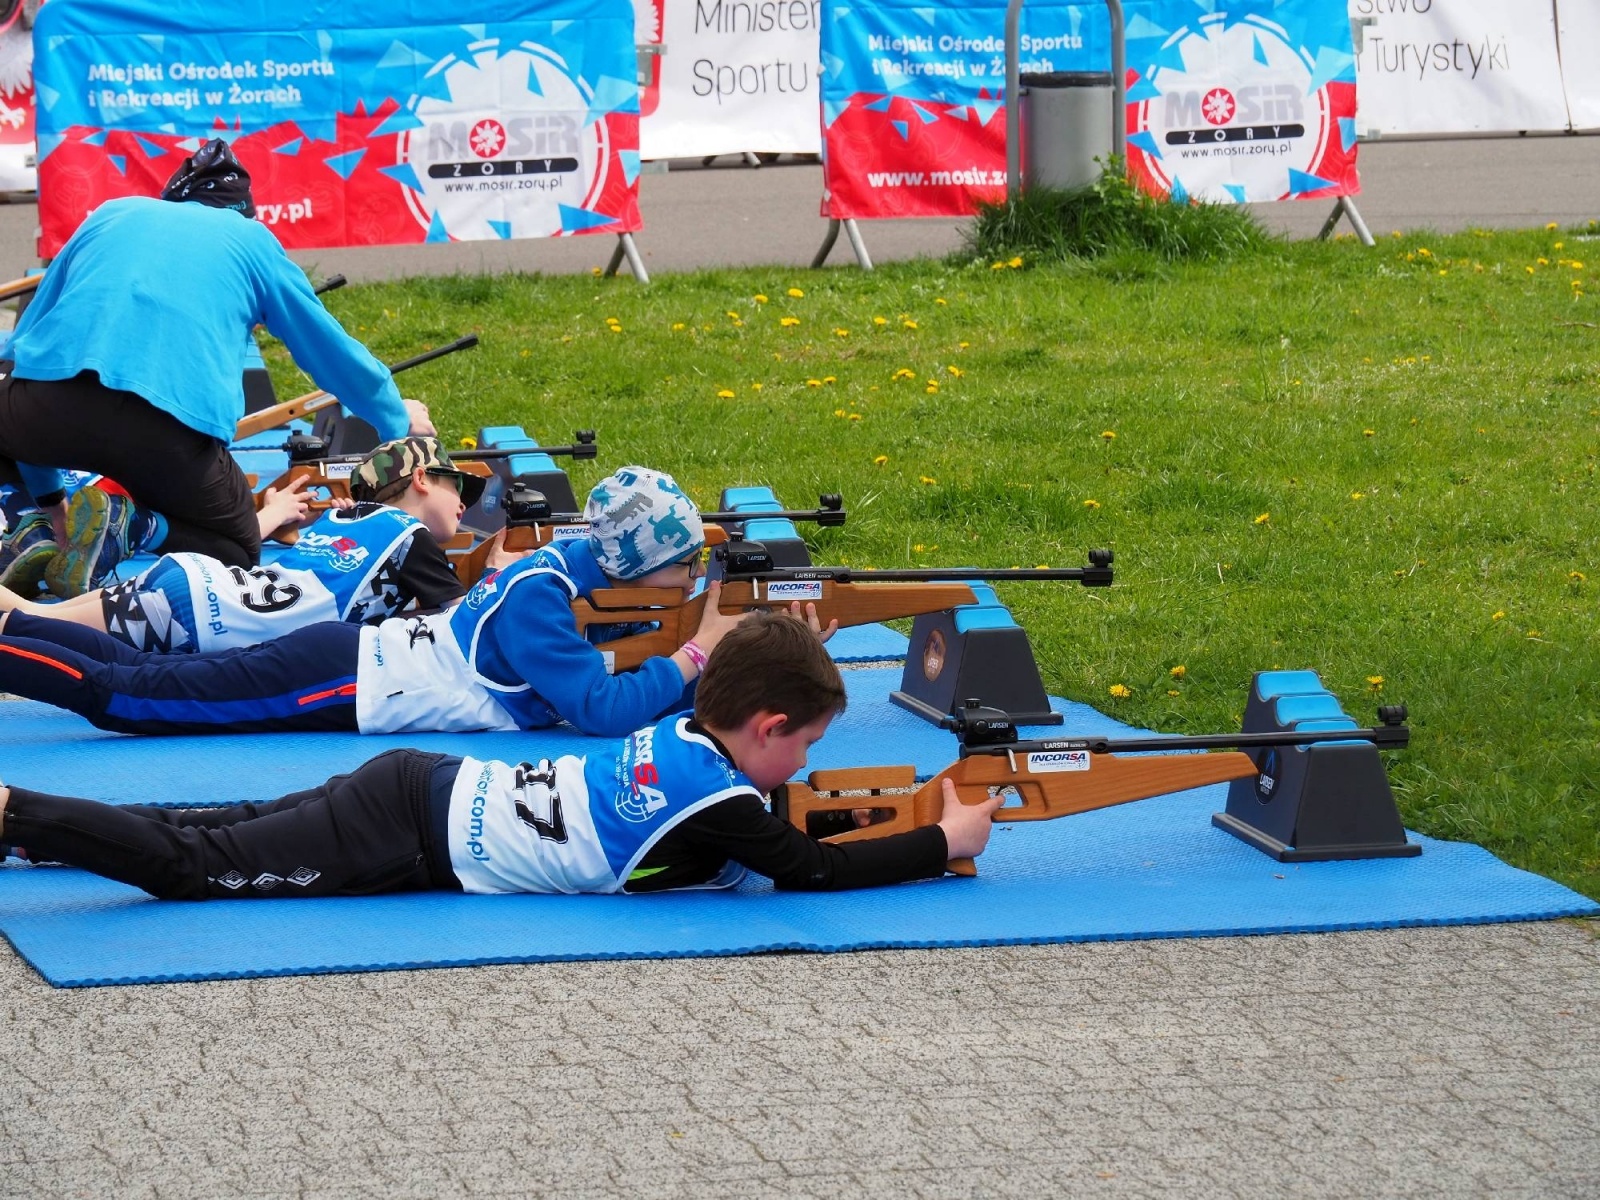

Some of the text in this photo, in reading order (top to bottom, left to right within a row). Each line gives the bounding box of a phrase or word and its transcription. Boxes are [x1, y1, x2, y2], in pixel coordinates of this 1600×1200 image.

[868, 34, 1083, 55] Miejski Ośrode Sportu
[1370, 34, 1510, 81] Turystyki
[88, 60, 335, 85] Miejski Ośrodek Sportu
[872, 58, 880, 75] i
[882, 58, 965, 79] Rekreacji
[969, 62, 986, 77] w
[693, 58, 808, 105] Sportu
[88, 82, 302, 110] i Rekreacji w Żorach
[1181, 141, 1292, 159] www.mosir.zory.pl
[444, 175, 563, 193] www.mosir.zory.pl
[554, 527, 591, 535] INCORS
[768, 583, 821, 592] INCORSA
[1031, 752, 1087, 763] INCORSA
